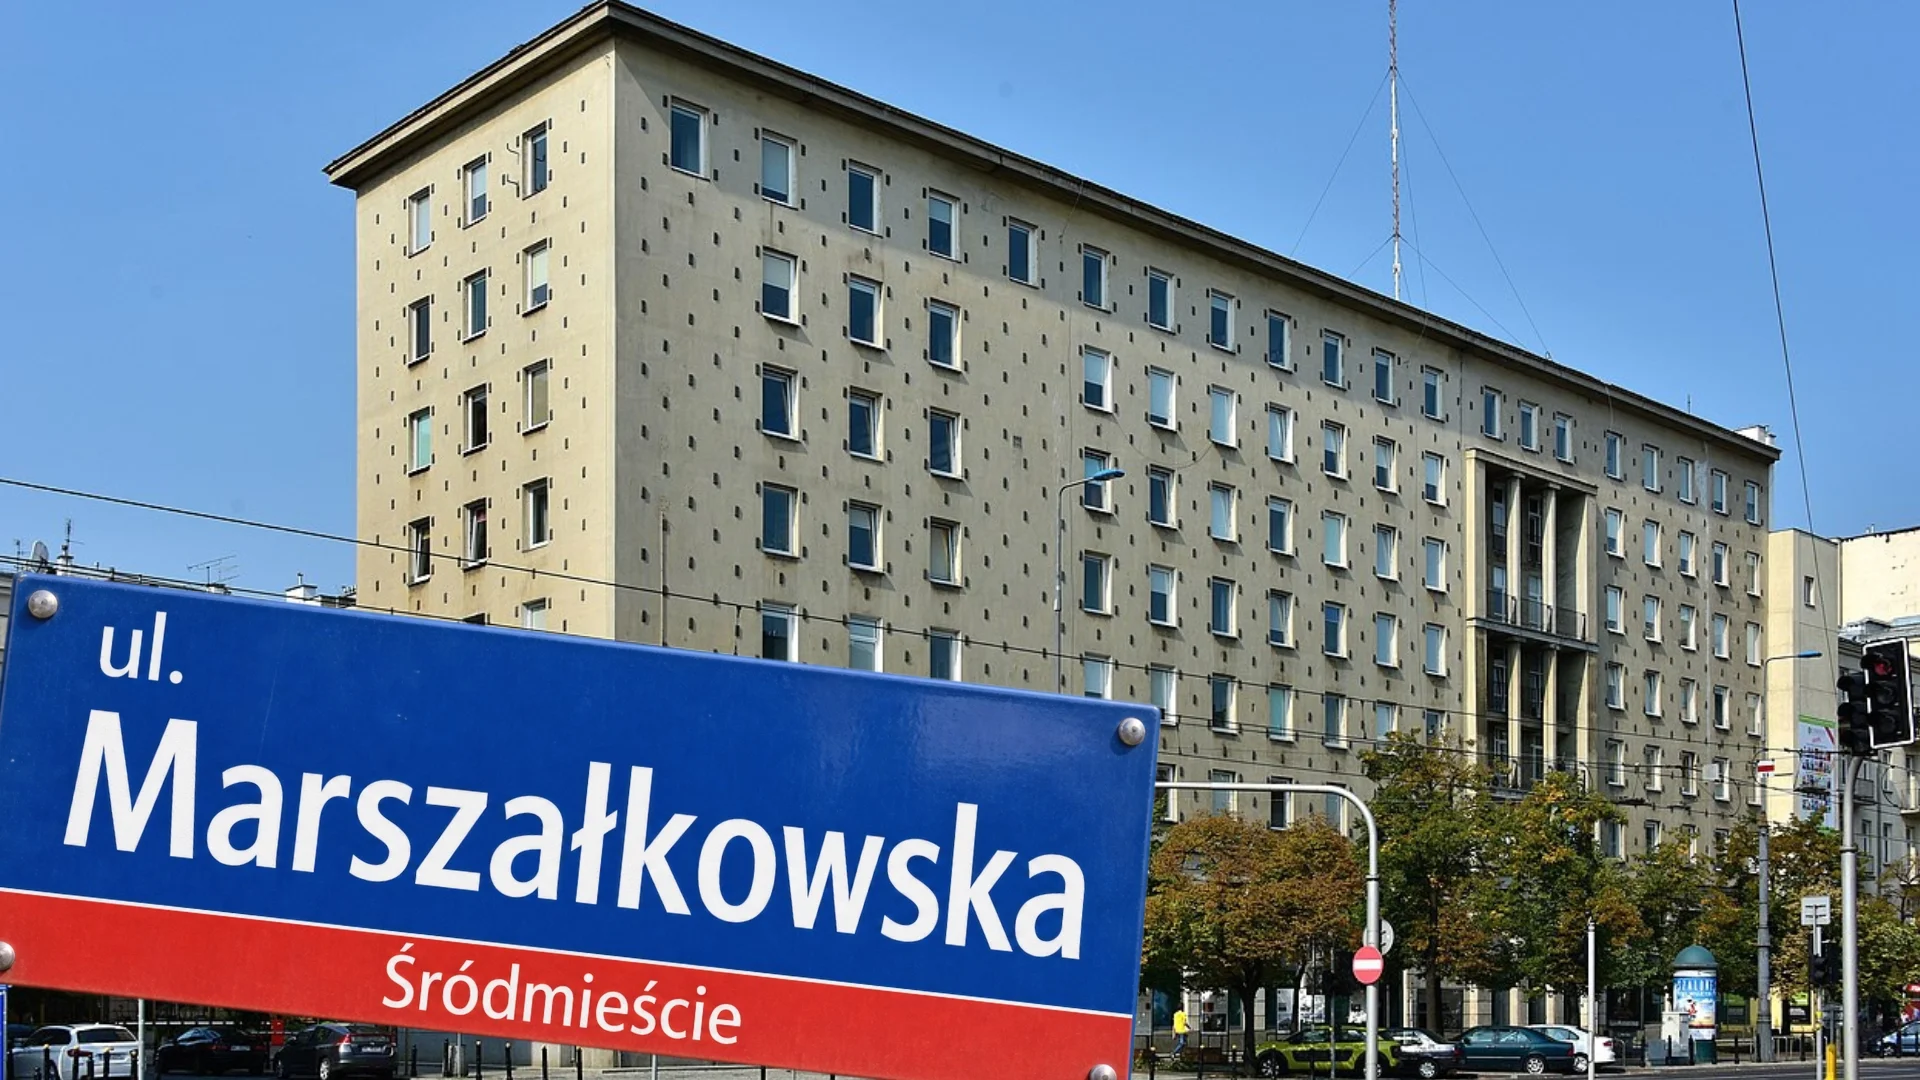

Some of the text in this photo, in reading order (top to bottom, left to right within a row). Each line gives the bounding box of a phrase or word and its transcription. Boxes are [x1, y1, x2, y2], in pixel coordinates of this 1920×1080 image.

[100, 611, 183, 684] ul.
[64, 710, 1085, 960] Marszałkowska
[382, 942, 742, 1045] Śródmieście
